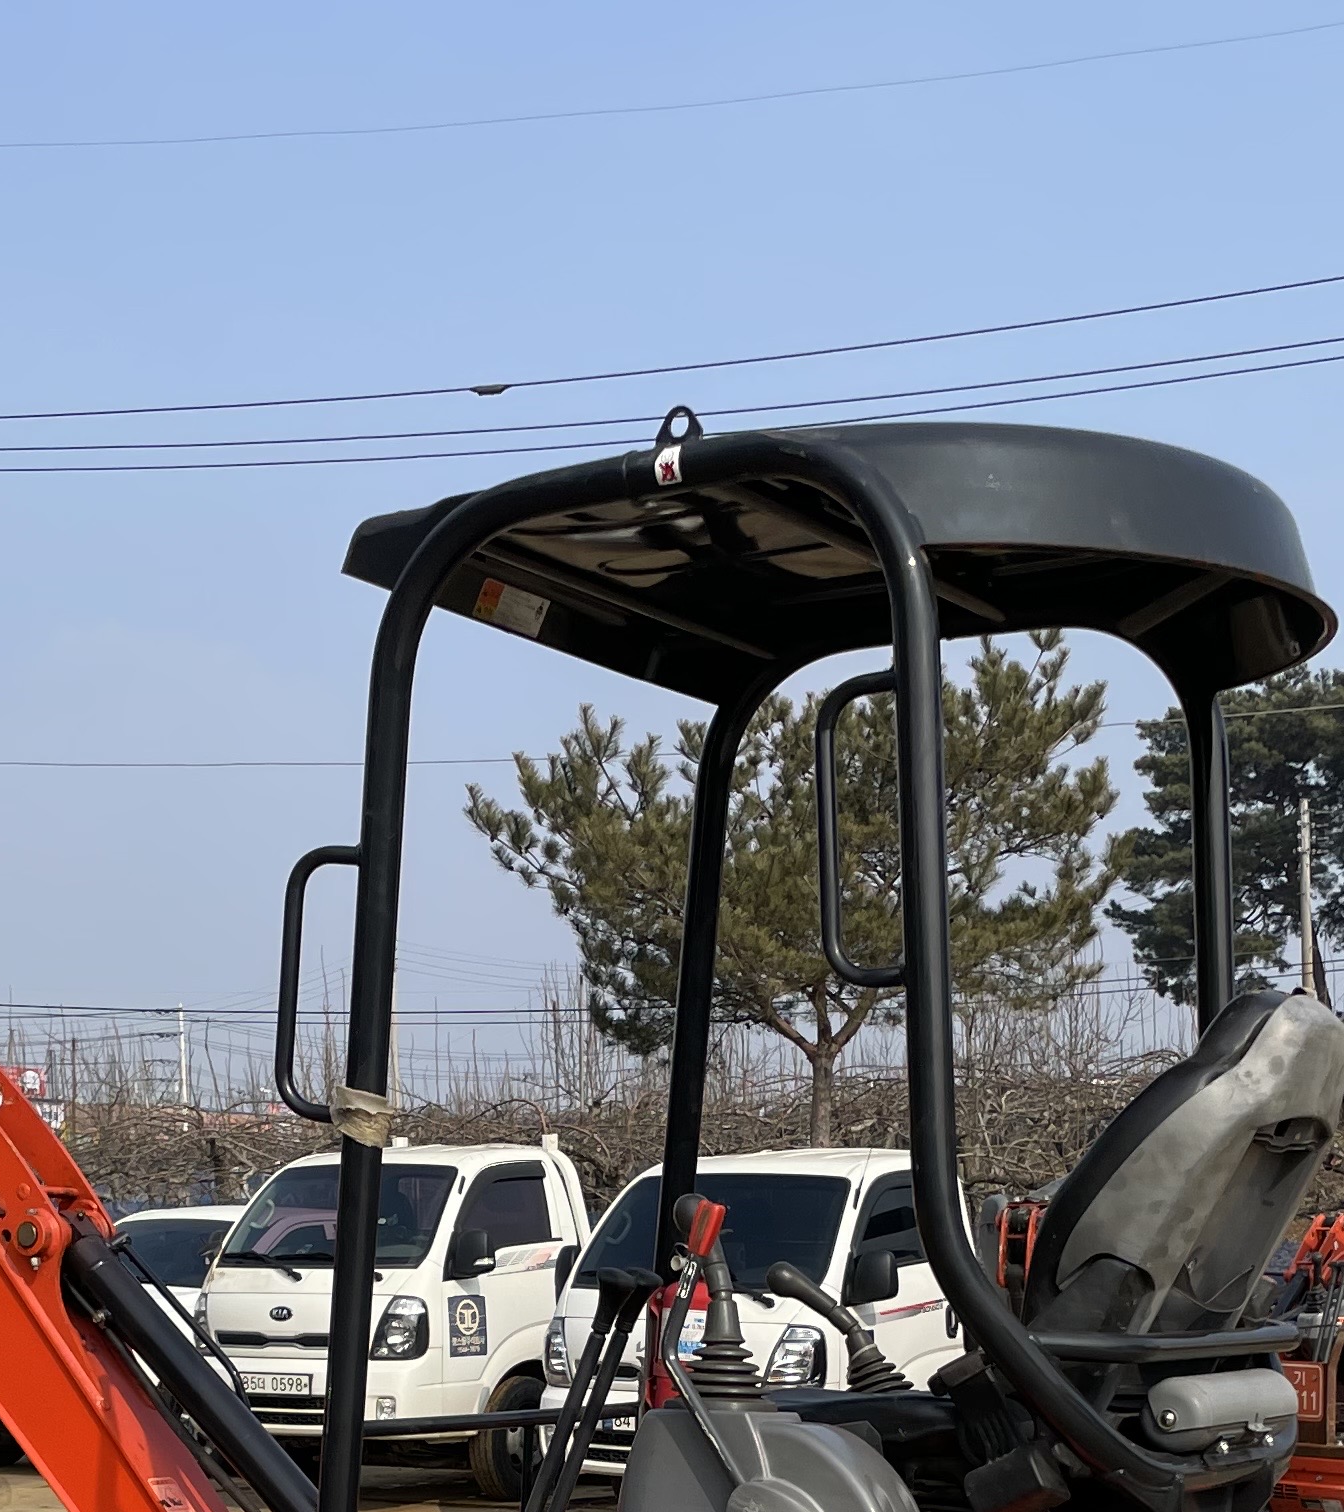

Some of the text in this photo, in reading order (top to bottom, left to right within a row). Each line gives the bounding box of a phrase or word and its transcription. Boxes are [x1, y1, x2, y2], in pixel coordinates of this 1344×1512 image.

[272, 1308, 289, 1318] KIA
[271, 1376, 303, 1393] 0598
[1294, 1371, 1306, 1386] 기
